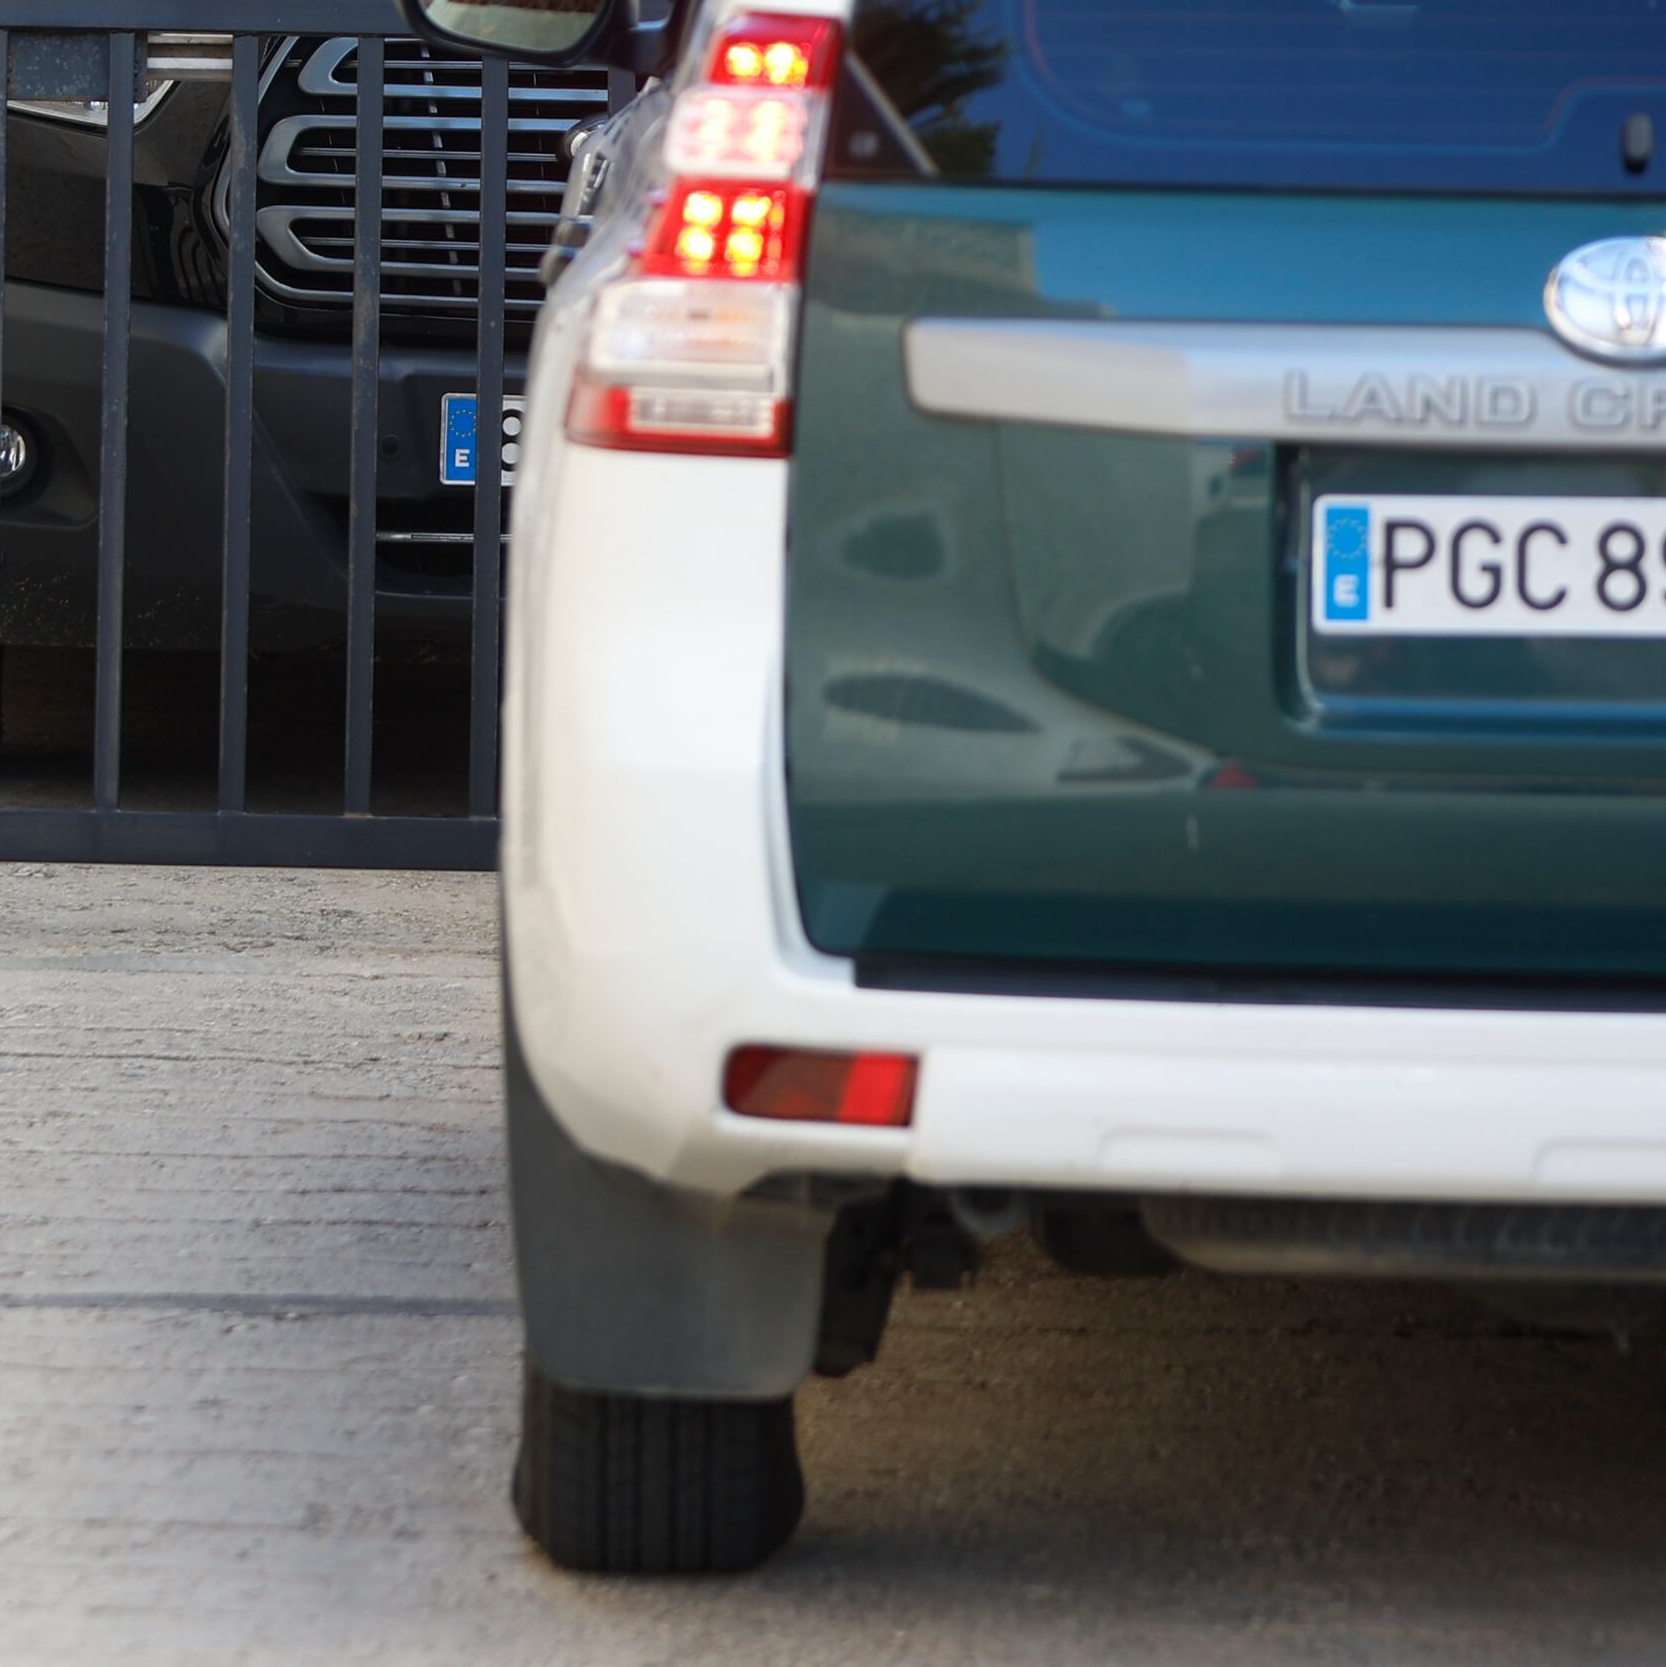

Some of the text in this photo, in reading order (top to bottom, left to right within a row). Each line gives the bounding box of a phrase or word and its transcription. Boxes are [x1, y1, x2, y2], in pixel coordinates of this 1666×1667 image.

[1283, 371, 1538, 426] LAND
[455, 448, 470, 467] E
[1382, 517, 1569, 613] PGC
[1334, 574, 1360, 607] E
